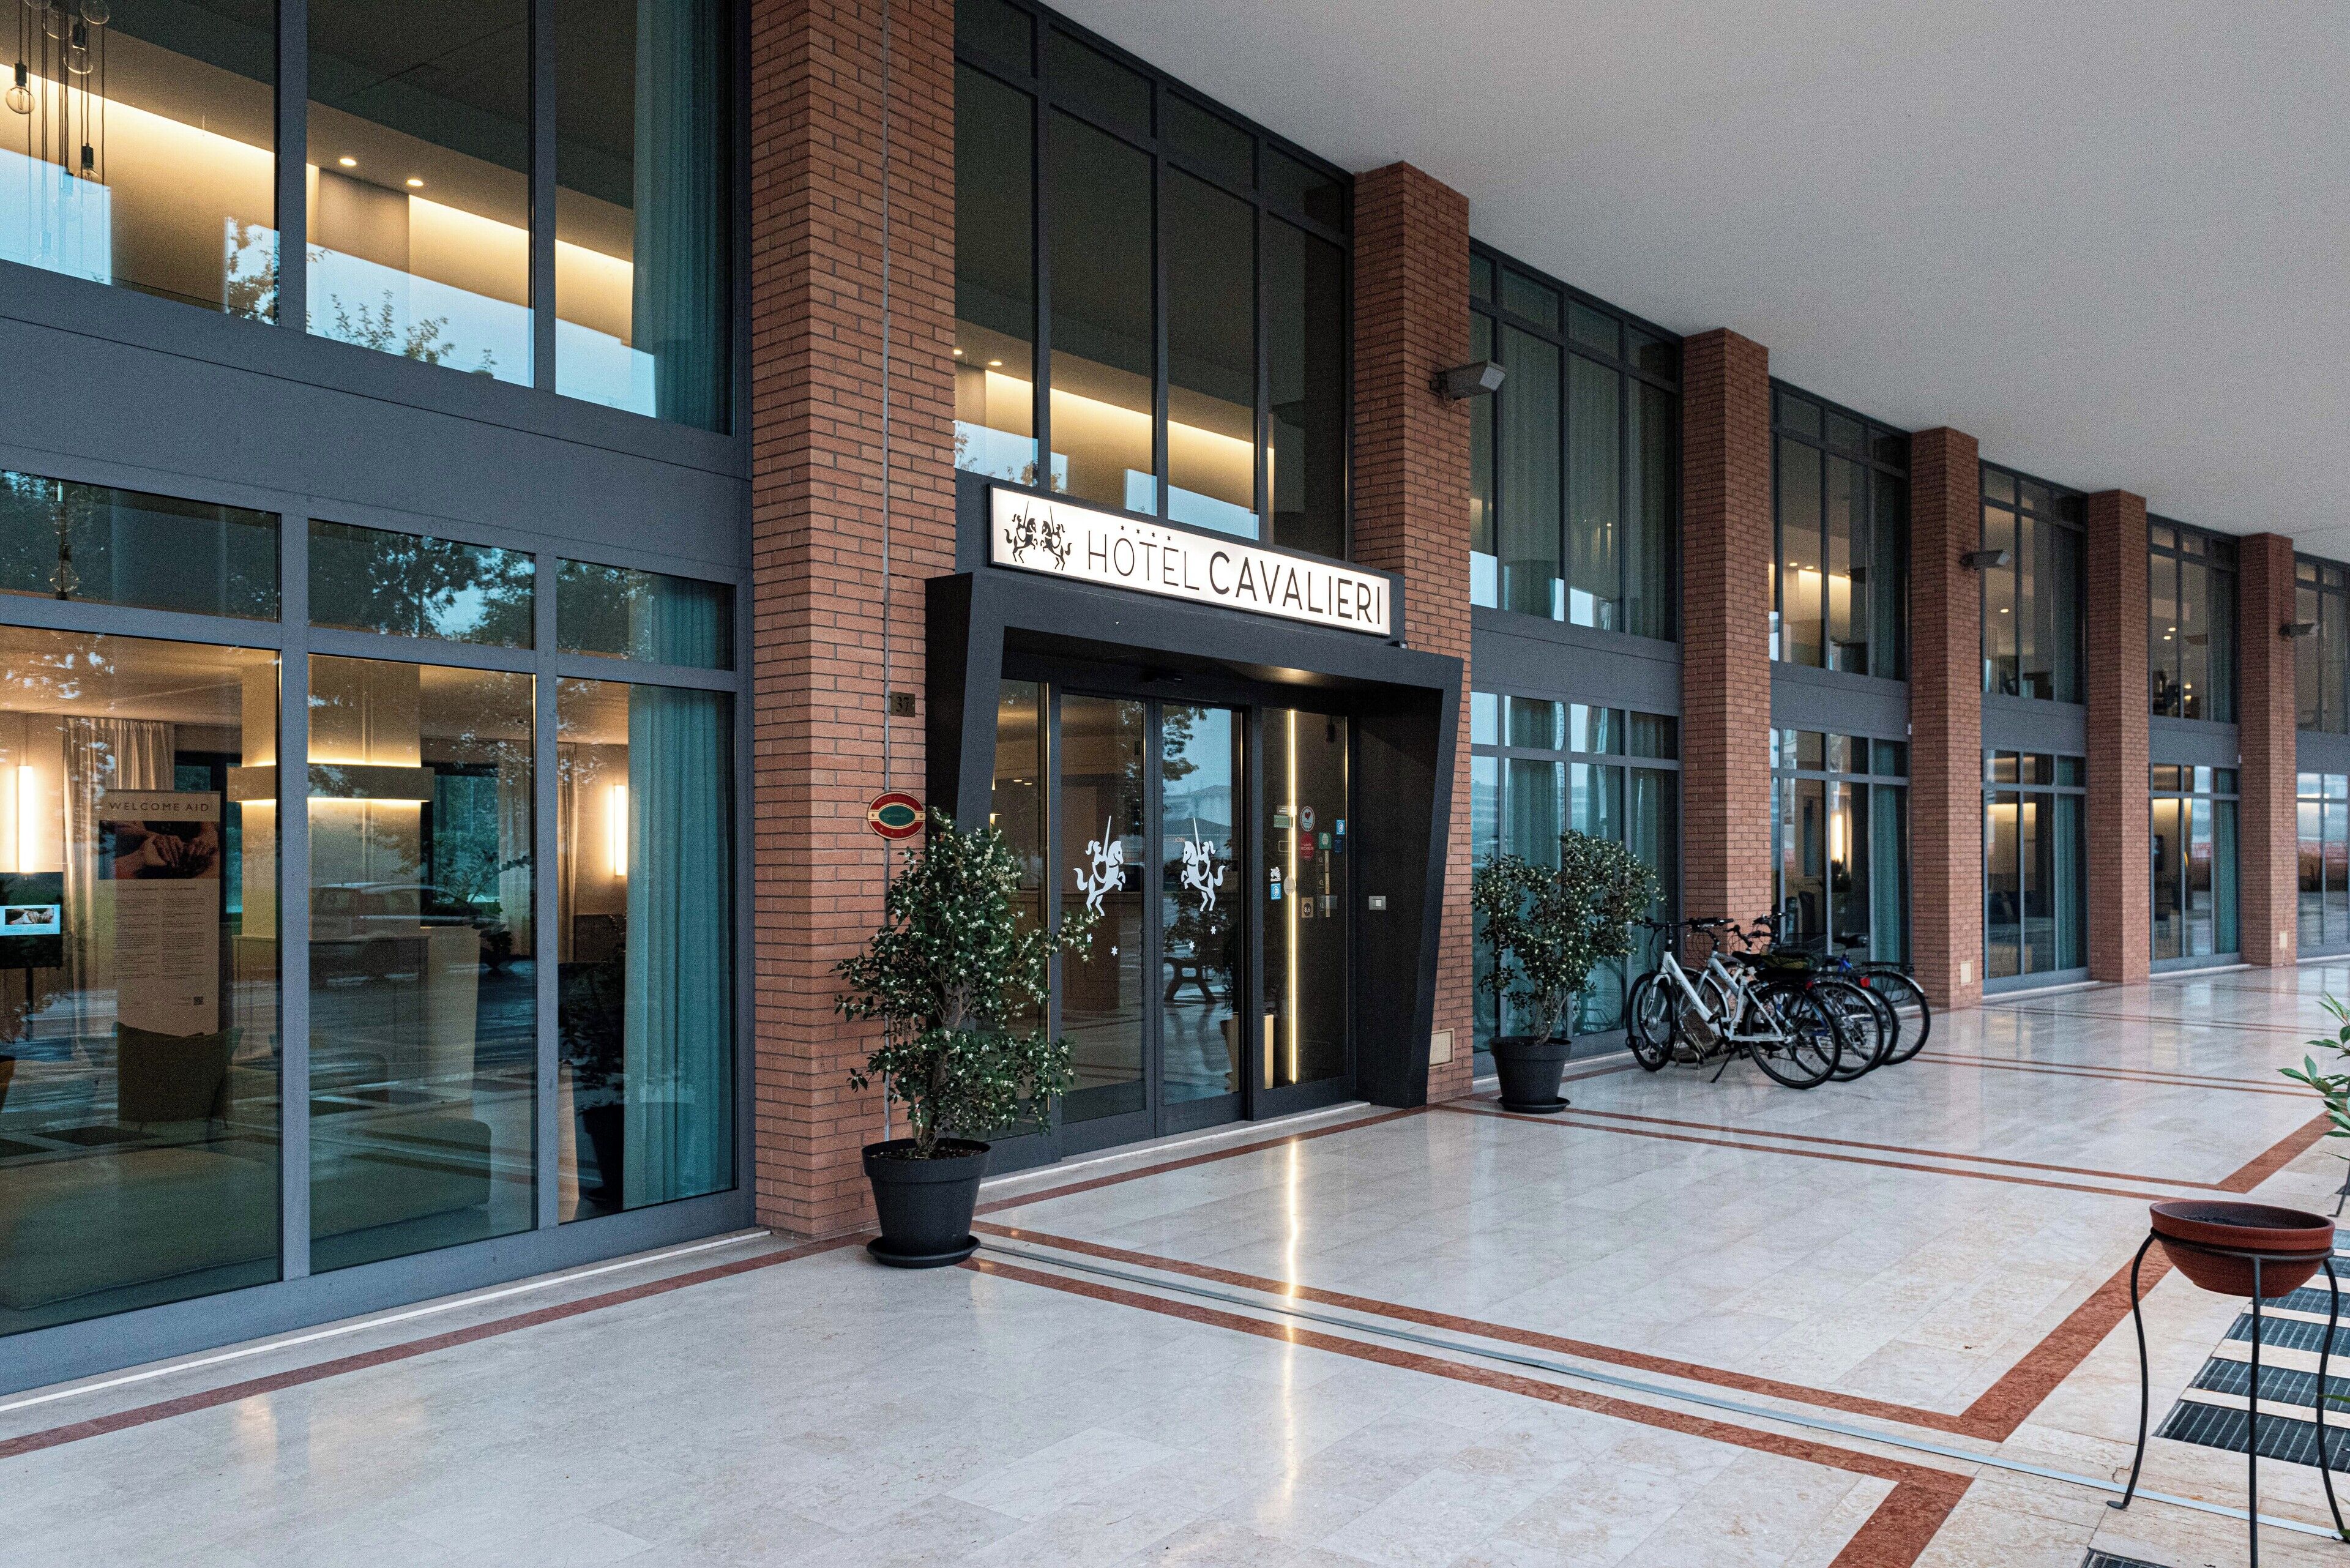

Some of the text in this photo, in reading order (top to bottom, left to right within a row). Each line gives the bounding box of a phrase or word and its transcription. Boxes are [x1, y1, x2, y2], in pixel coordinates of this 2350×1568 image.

[1088, 530, 1381, 624] HOTEL CAVALIERI
[895, 696, 910, 712] 37
[109, 802, 209, 812] WELCOME AID
